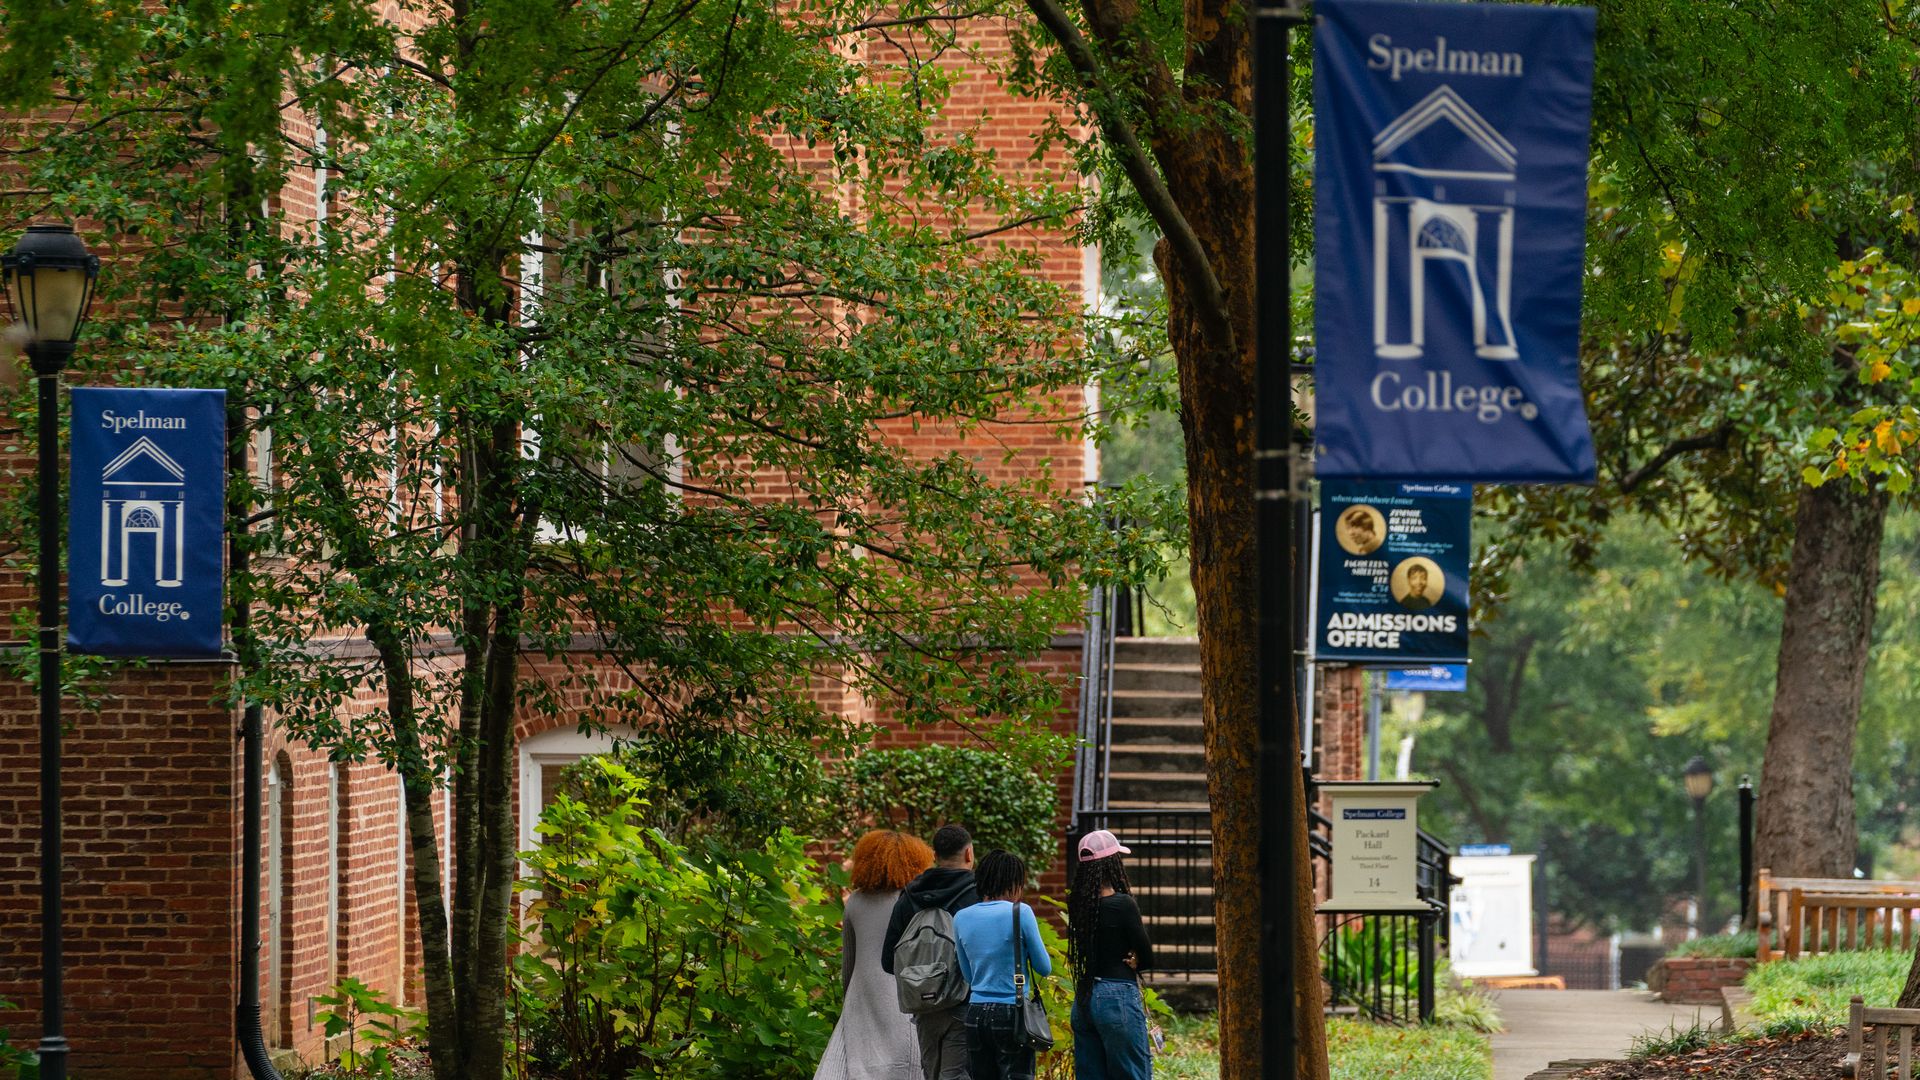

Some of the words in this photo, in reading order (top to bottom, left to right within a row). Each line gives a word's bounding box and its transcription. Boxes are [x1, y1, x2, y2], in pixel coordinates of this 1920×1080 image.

[1366, 33, 1523, 80] Spelman
[101, 410, 187, 434] Spelman
[1402, 484, 1433, 494] Spelman
[1327, 612, 1457, 632] ADMISSIONS
[1327, 630, 1400, 648] OFFICE
[1344, 810, 1376, 819] Spelman
[1377, 810, 1405, 819] College
[1355, 829, 1390, 839] Packard
[1364, 840, 1382, 849] Hall
[1368, 877, 1381, 887] 14
